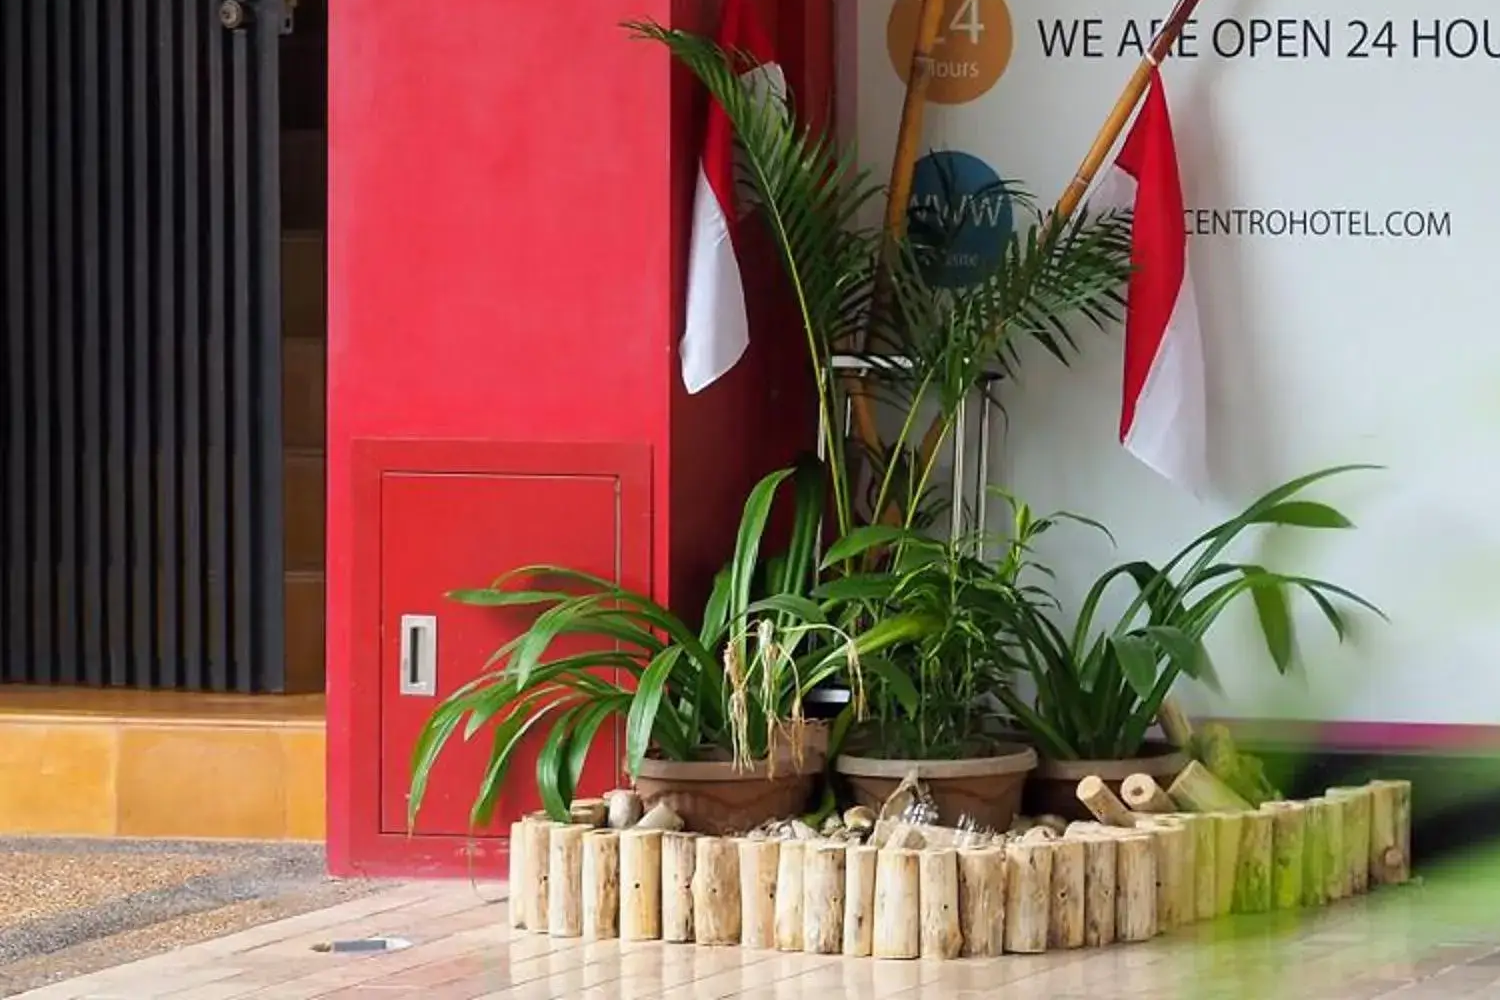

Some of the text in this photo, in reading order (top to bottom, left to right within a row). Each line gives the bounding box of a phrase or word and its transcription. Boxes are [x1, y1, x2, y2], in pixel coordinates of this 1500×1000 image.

[1037, 19, 1104, 57] WE
[1212, 16, 1330, 58] OPEN
[1346, 20, 1399, 58] 24
